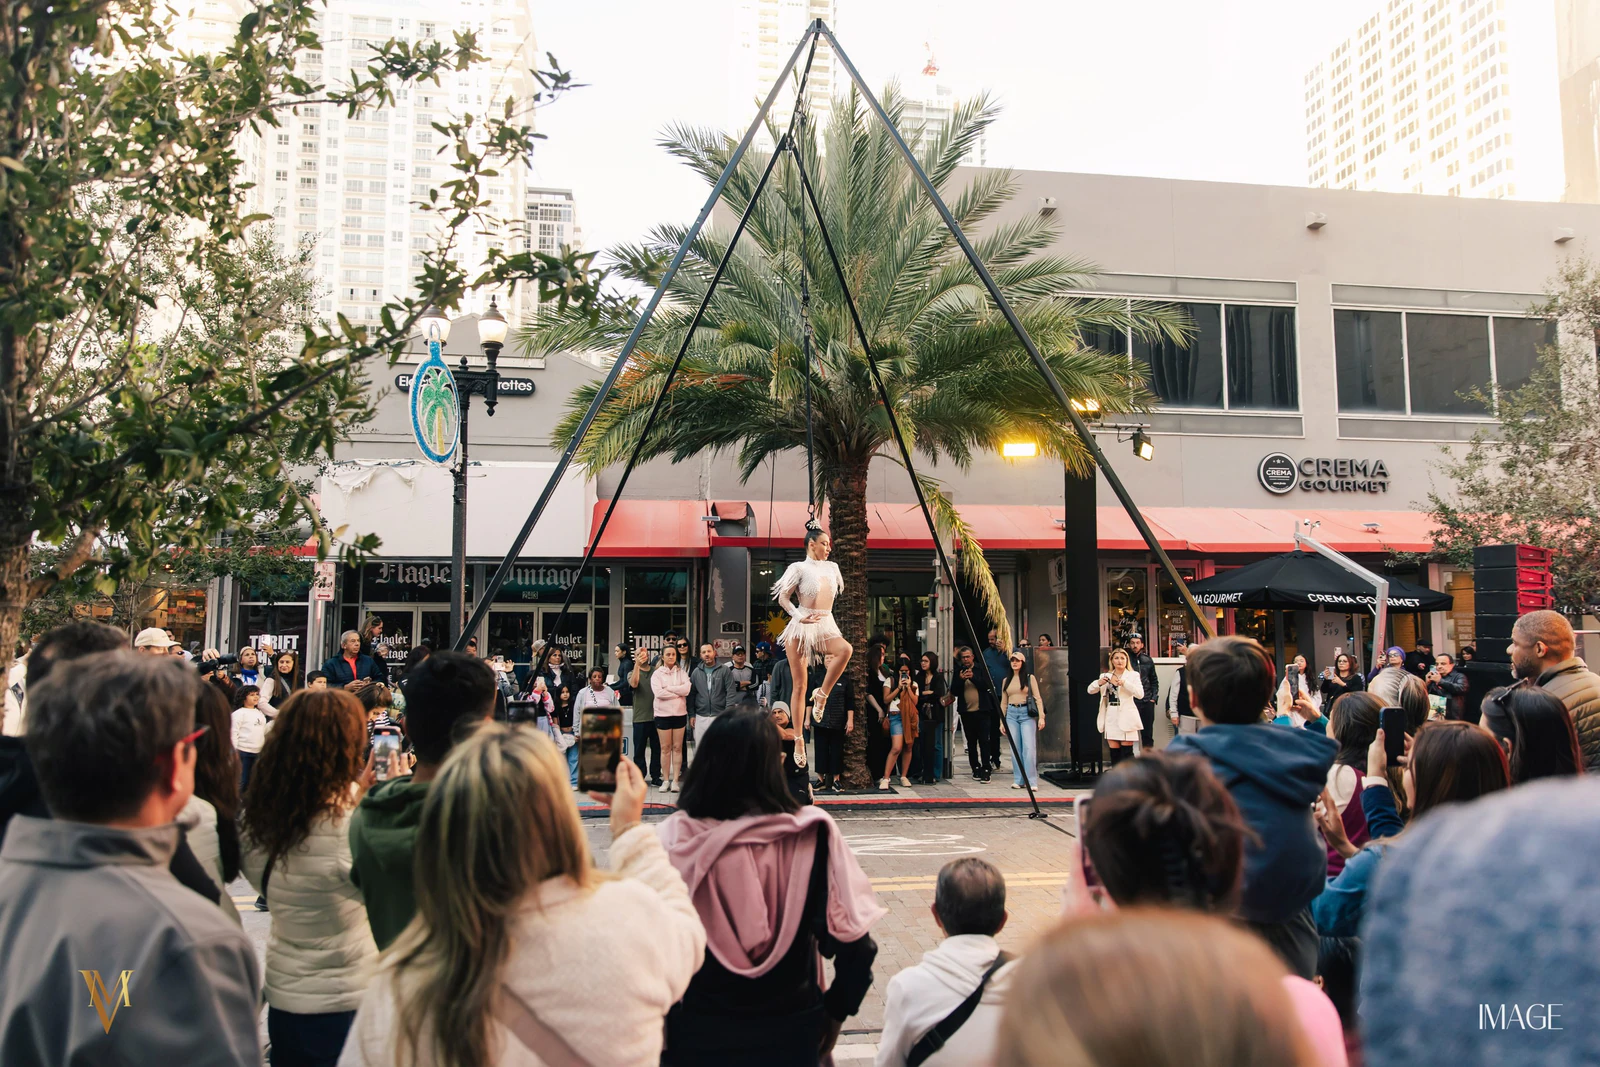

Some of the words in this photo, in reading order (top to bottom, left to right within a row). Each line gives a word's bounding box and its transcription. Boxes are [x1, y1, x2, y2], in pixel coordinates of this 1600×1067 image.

[1299, 458, 1390, 478] CREMA
[1299, 480, 1391, 493] GOURMET
[1203, 592, 1243, 604] GOURMET
[1307, 593, 1356, 604] CREMA
[1356, 596, 1420, 607] GORMET
